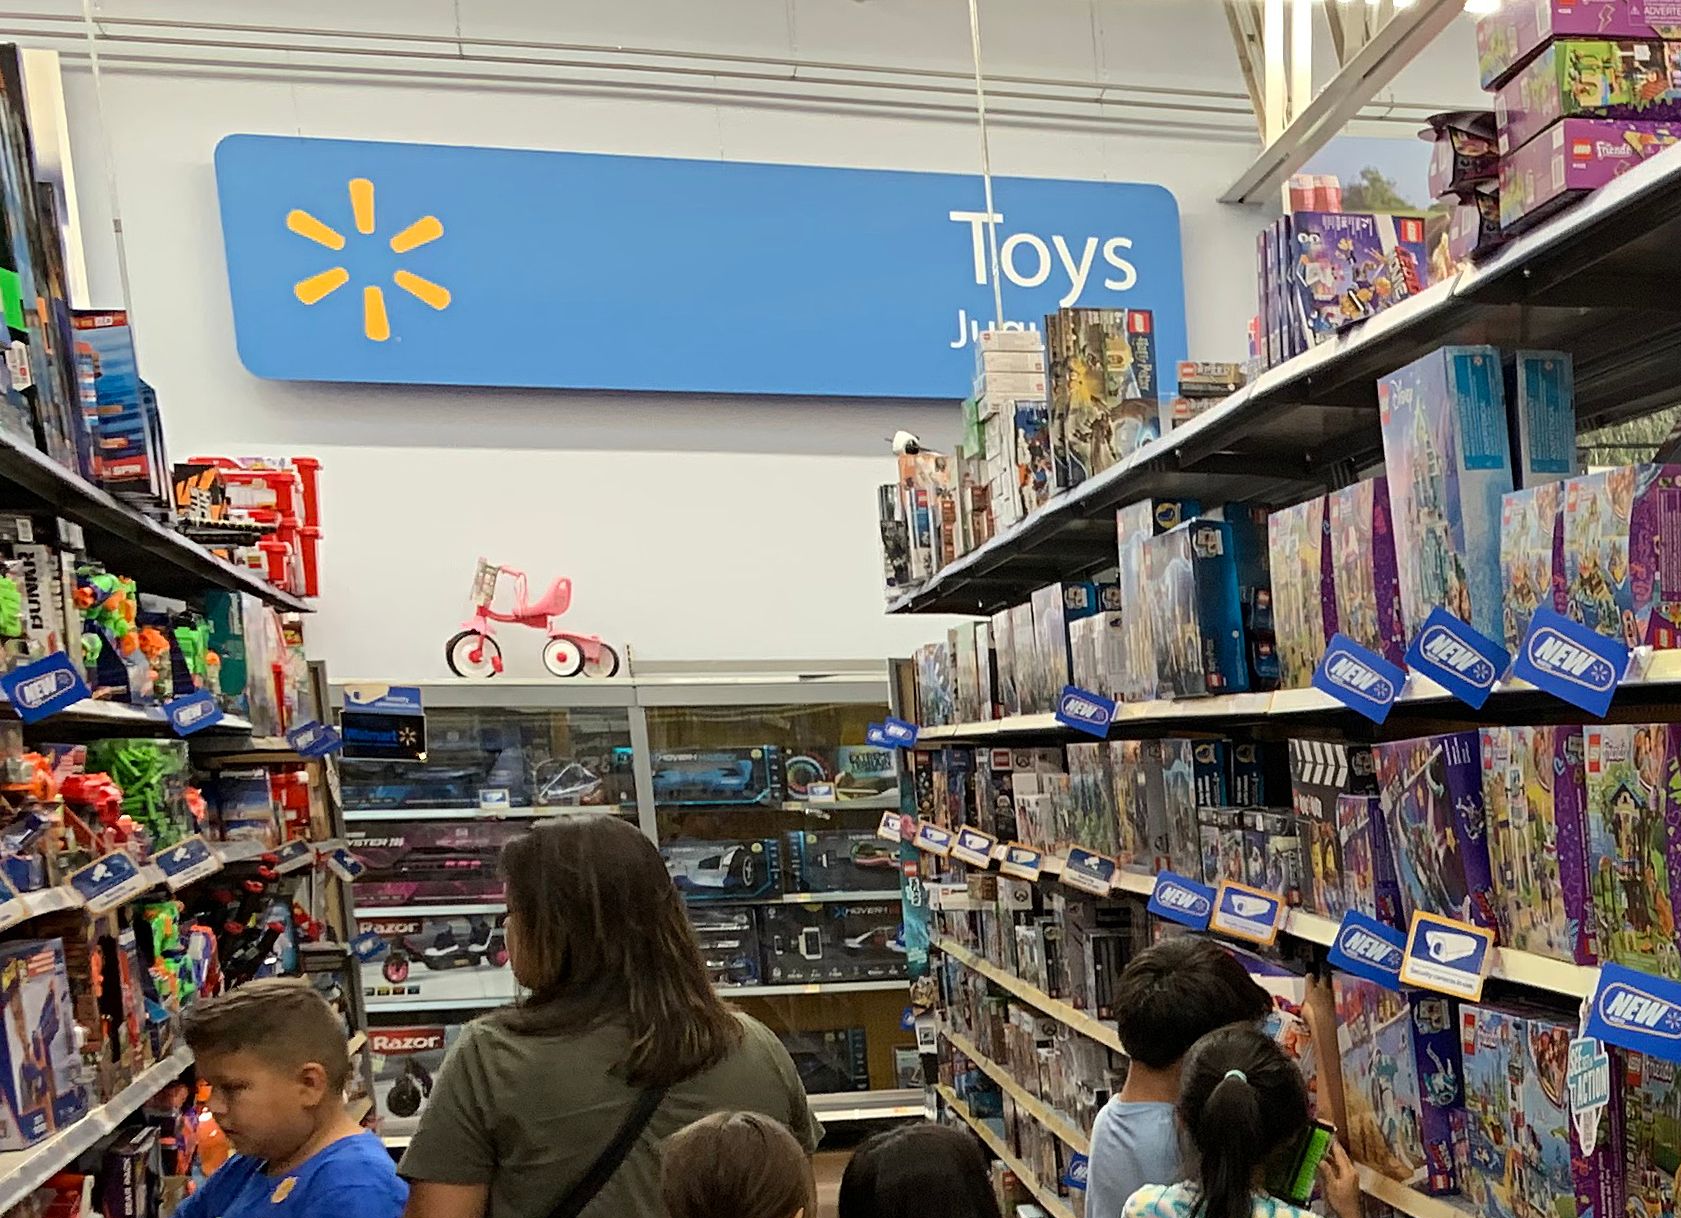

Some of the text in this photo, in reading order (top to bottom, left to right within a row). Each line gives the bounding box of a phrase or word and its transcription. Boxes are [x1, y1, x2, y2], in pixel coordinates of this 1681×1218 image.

[949, 211, 1137, 308] Toys
[1424, 634, 1475, 672] NEW
[1535, 636, 1591, 676] NEW
[1329, 658, 1376, 691] NEW
[1064, 699, 1097, 721] NEW
[1160, 887, 1196, 911] NEW
[360, 921, 419, 934] Razor
[1345, 932, 1392, 962] NEW
[1606, 991, 1669, 1029] NEW
[374, 1037, 440, 1050] Razor
